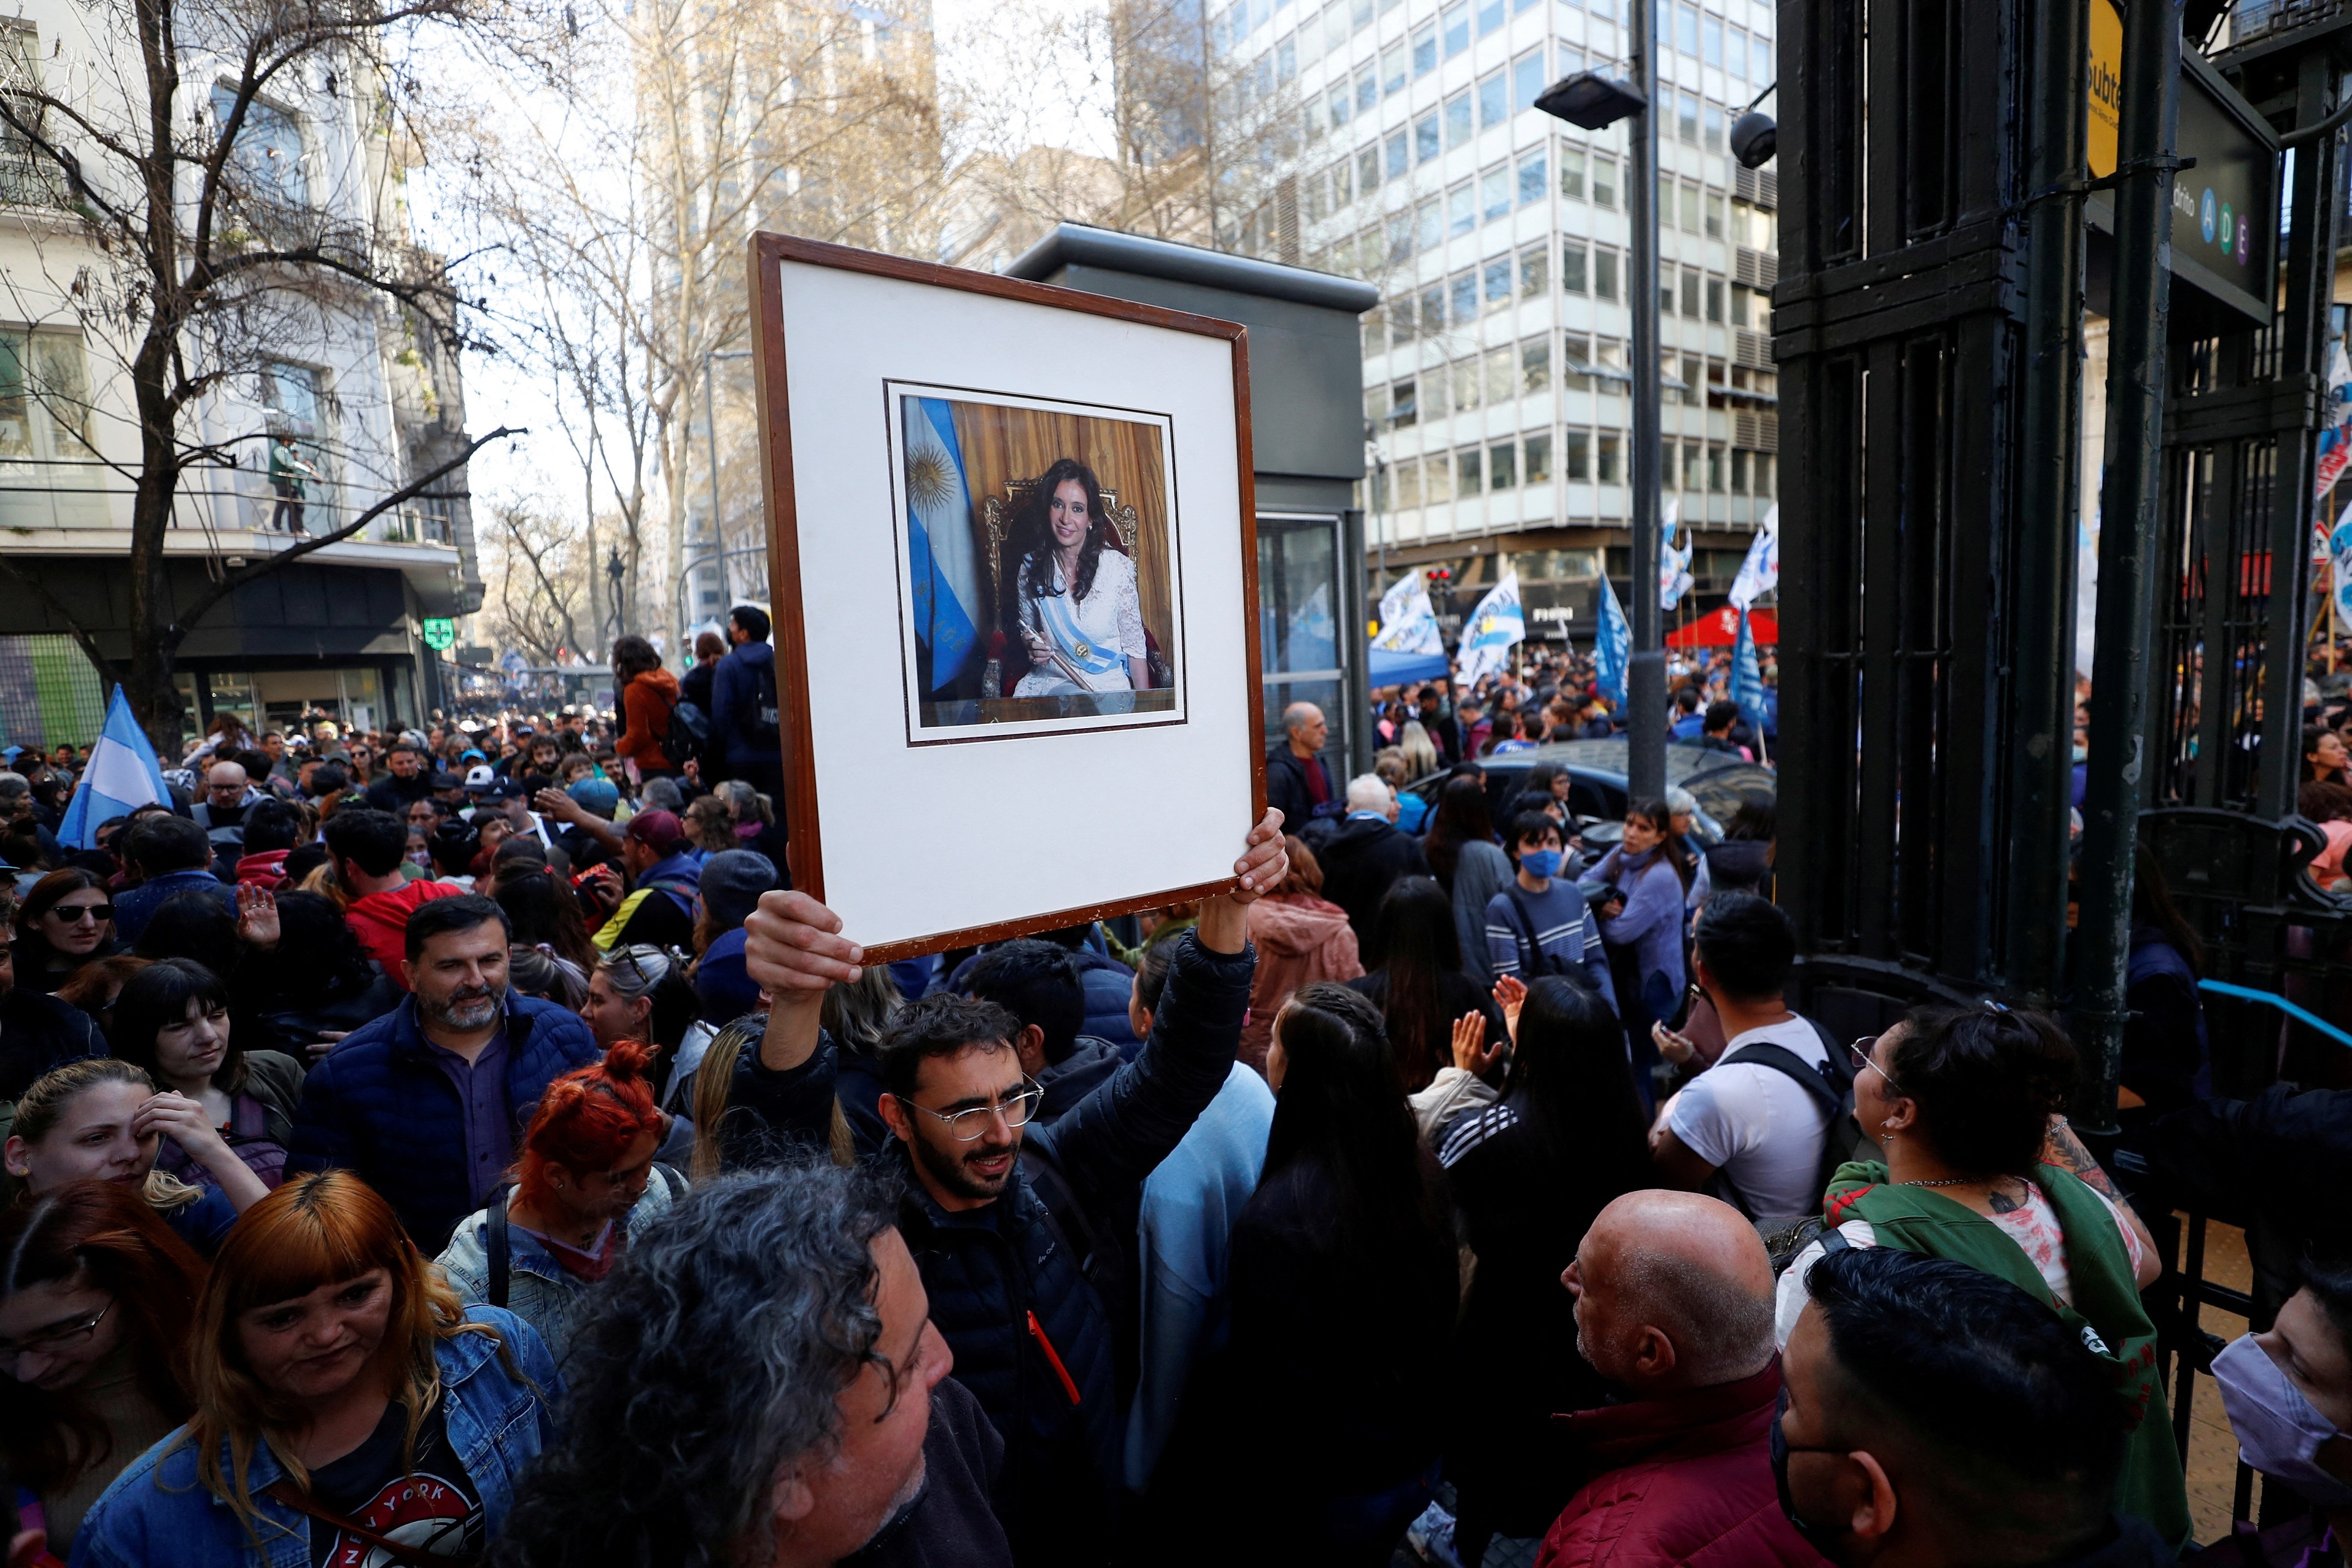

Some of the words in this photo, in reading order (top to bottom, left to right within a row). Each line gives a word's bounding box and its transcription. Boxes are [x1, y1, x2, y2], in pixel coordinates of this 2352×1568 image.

[2203, 199, 2213, 231] A
[2222, 212, 2231, 243] D
[2238, 223, 2246, 254] E
[384, 1483, 444, 1511] YORK
